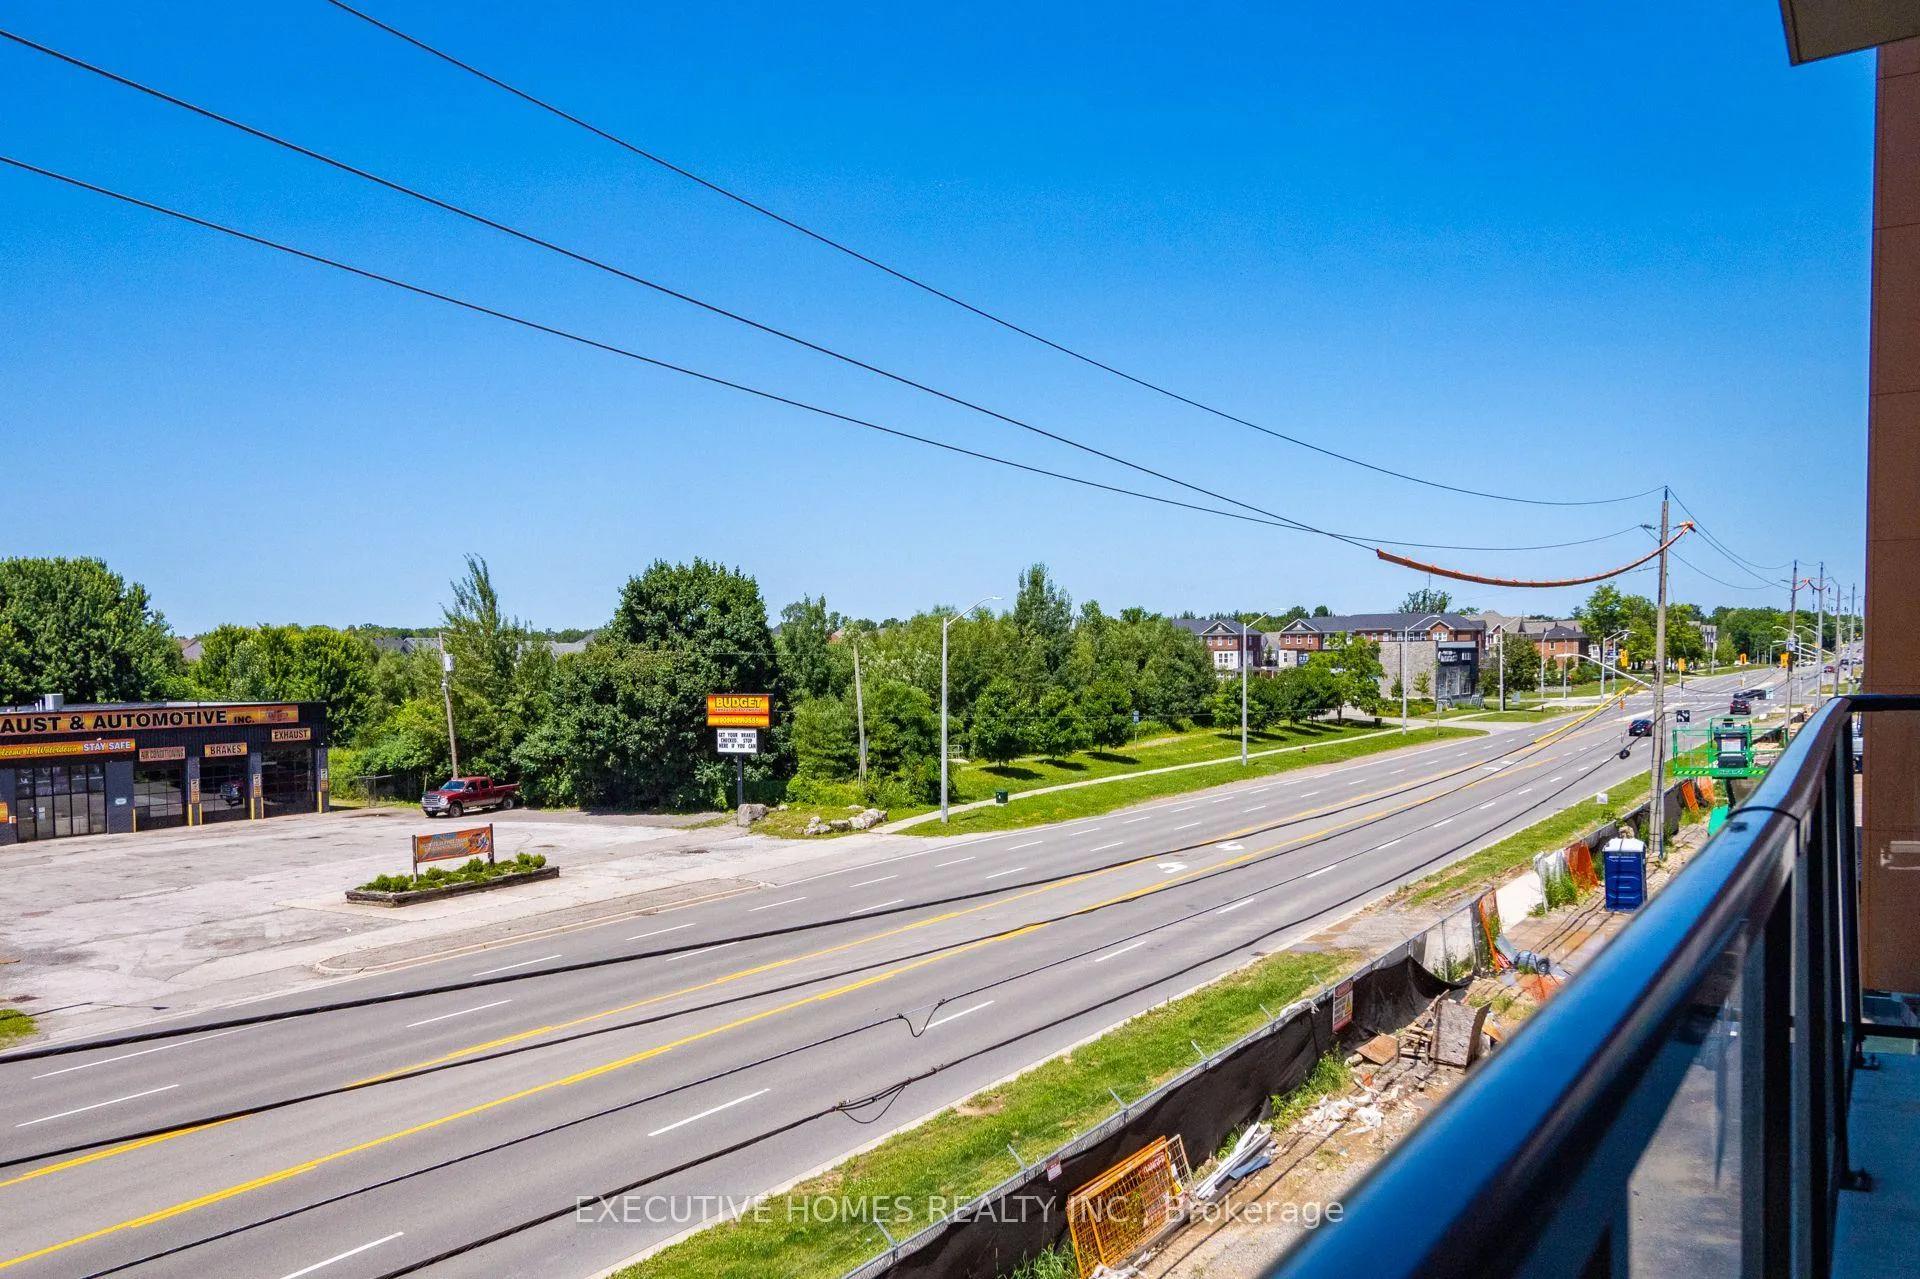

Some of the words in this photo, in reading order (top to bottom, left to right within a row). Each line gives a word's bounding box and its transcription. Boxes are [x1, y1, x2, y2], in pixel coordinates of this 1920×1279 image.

[715, 697, 762, 708] BUDGET
[70, 716, 85, 730] &
[93, 710, 227, 729] AUTOMOTIVE
[234, 716, 256, 725] INC.
[274, 731, 308, 740] EXHAUST
[37, 744, 78, 755] Waterdown
[83, 743, 107, 751] STAY
[109, 741, 131, 749] SAFE
[210, 745, 242, 755] BRAKES
